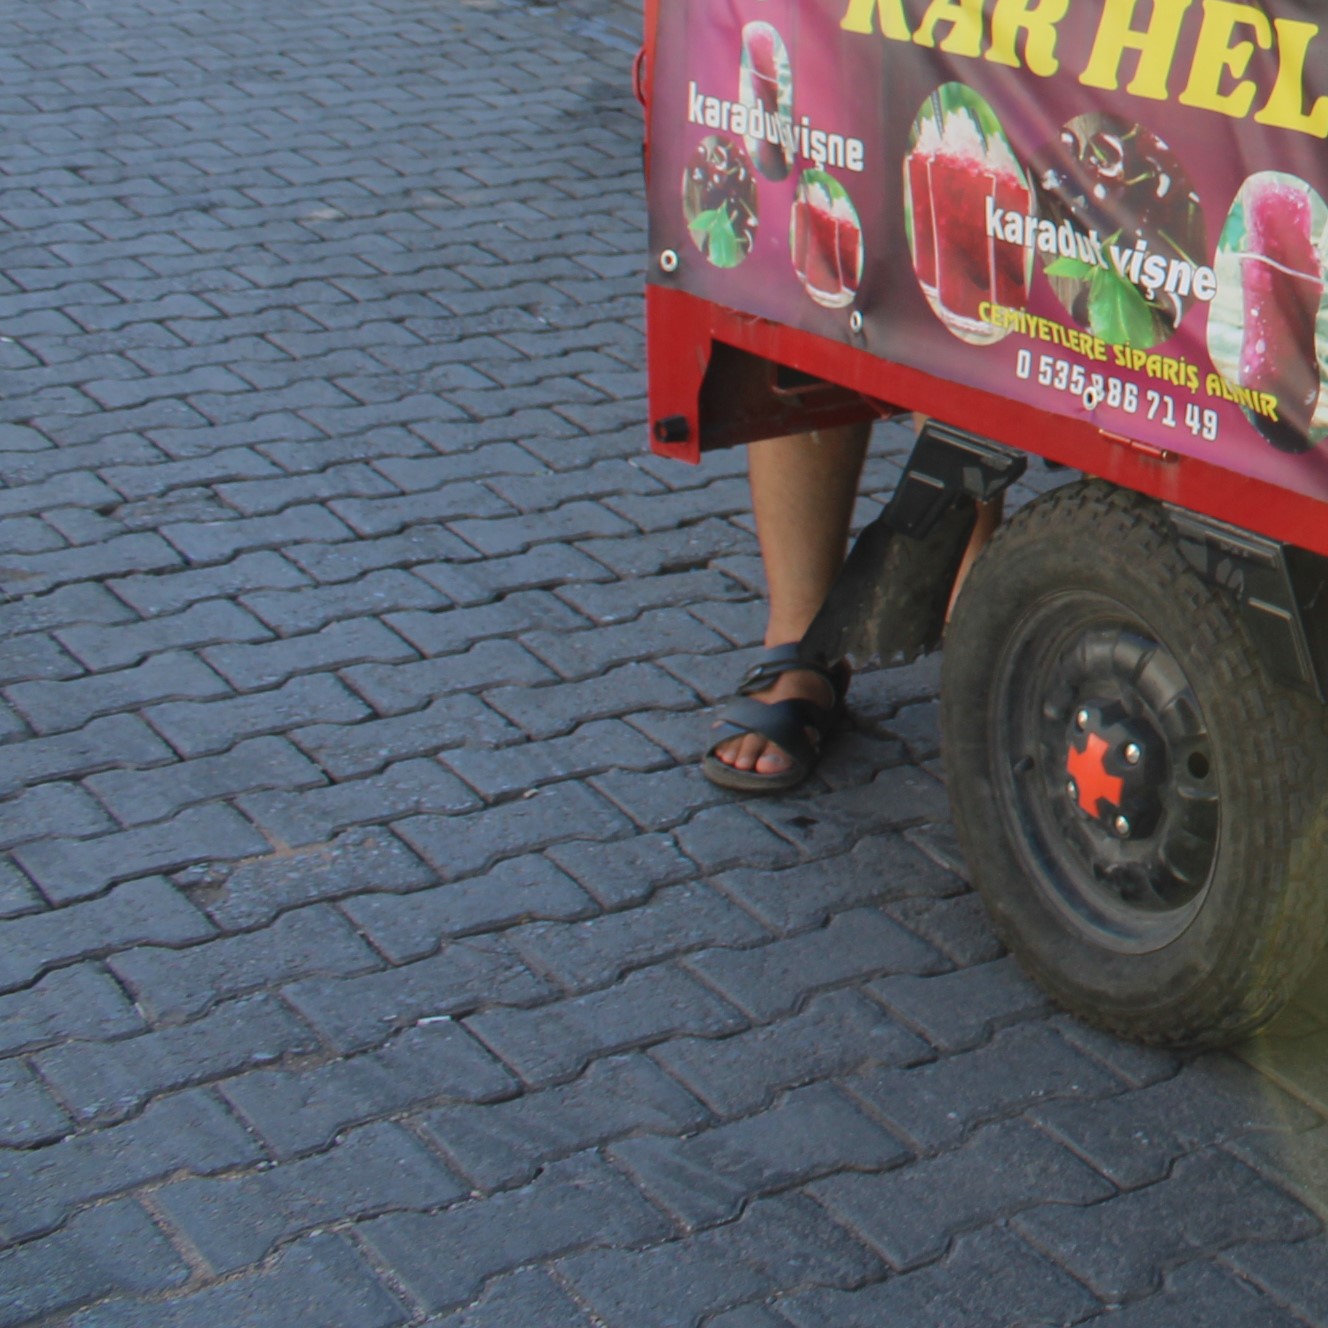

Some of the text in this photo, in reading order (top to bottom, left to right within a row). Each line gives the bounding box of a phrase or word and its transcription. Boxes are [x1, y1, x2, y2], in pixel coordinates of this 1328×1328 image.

[785, 115, 865, 172] vişne
[985, 195, 1217, 302] karadut vişne
[978, 301, 1279, 422] CEMİYETLERE SİPARİŞ ALINIR
[1016, 349, 1031, 379] 0
[1038, 354, 1085, 395] 535
[1146, 391, 1176, 427] 71
[1184, 403, 1218, 442] 49
